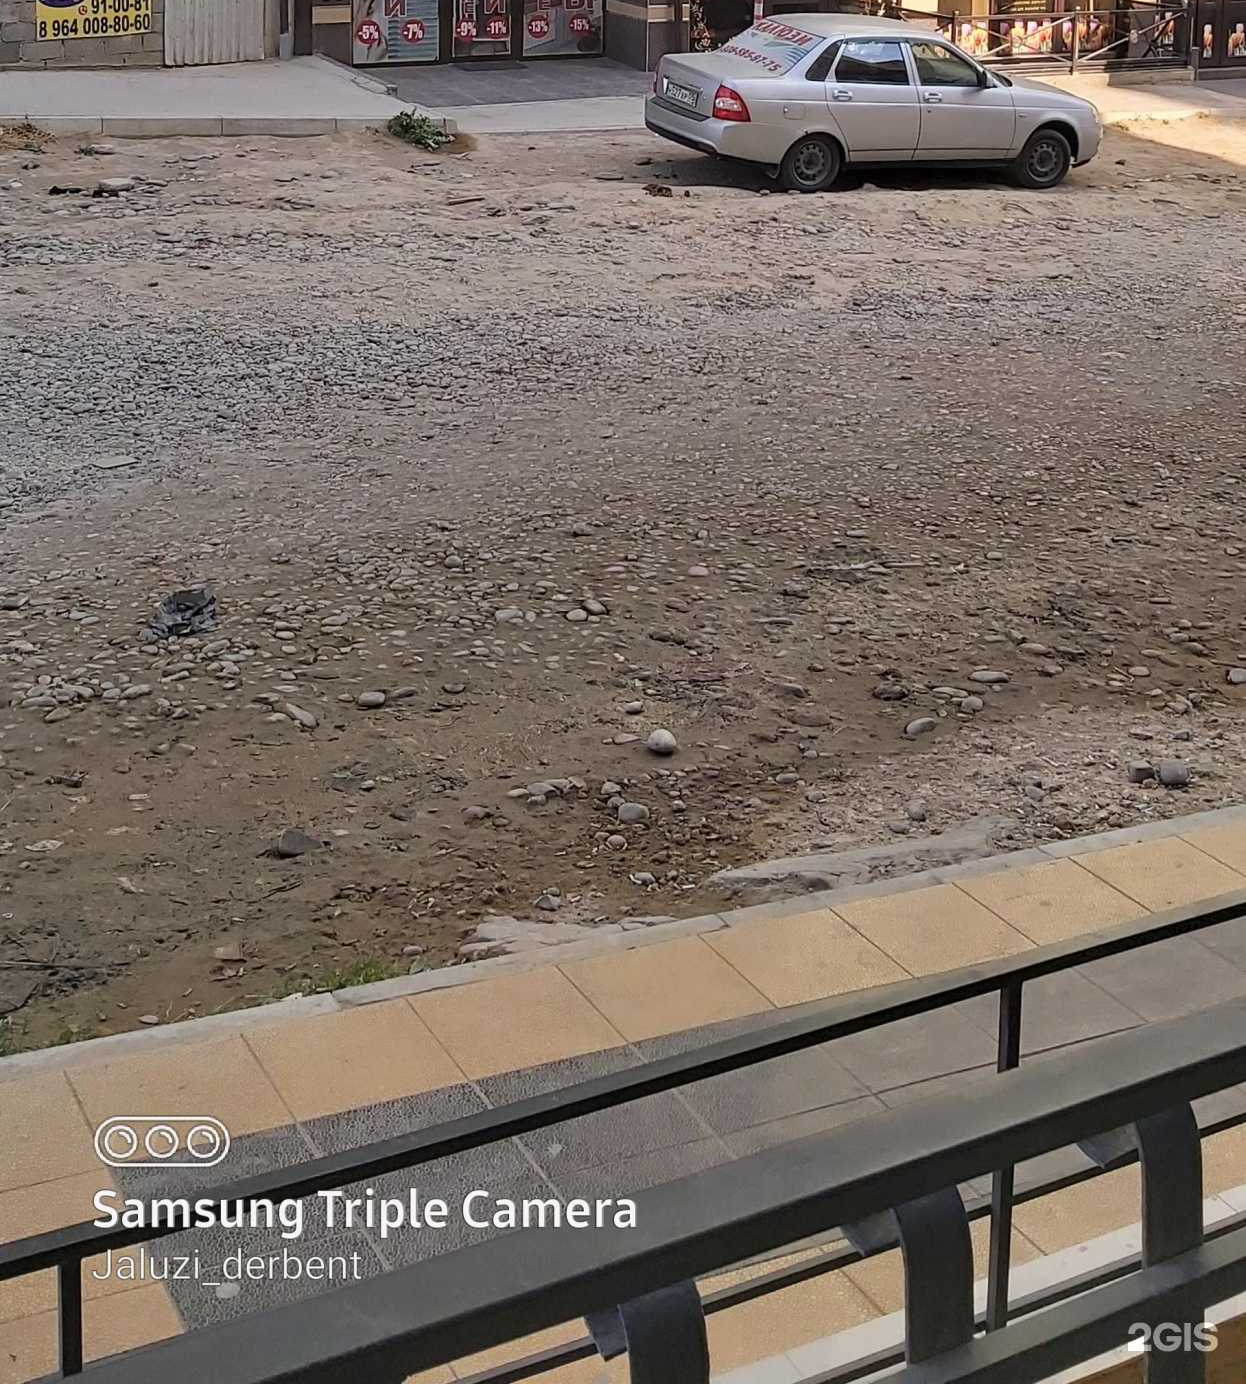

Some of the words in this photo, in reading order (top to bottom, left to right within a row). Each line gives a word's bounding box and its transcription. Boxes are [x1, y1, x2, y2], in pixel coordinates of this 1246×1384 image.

[39, 21, 48, 38] 8
[52, 18, 78, 37] 964
[83, 13, 150, 34] 008-80-60
[357, 24, 379, 40] -5%
[403, 23, 424, 39] -7%
[456, 22, 477, 37] -9%
